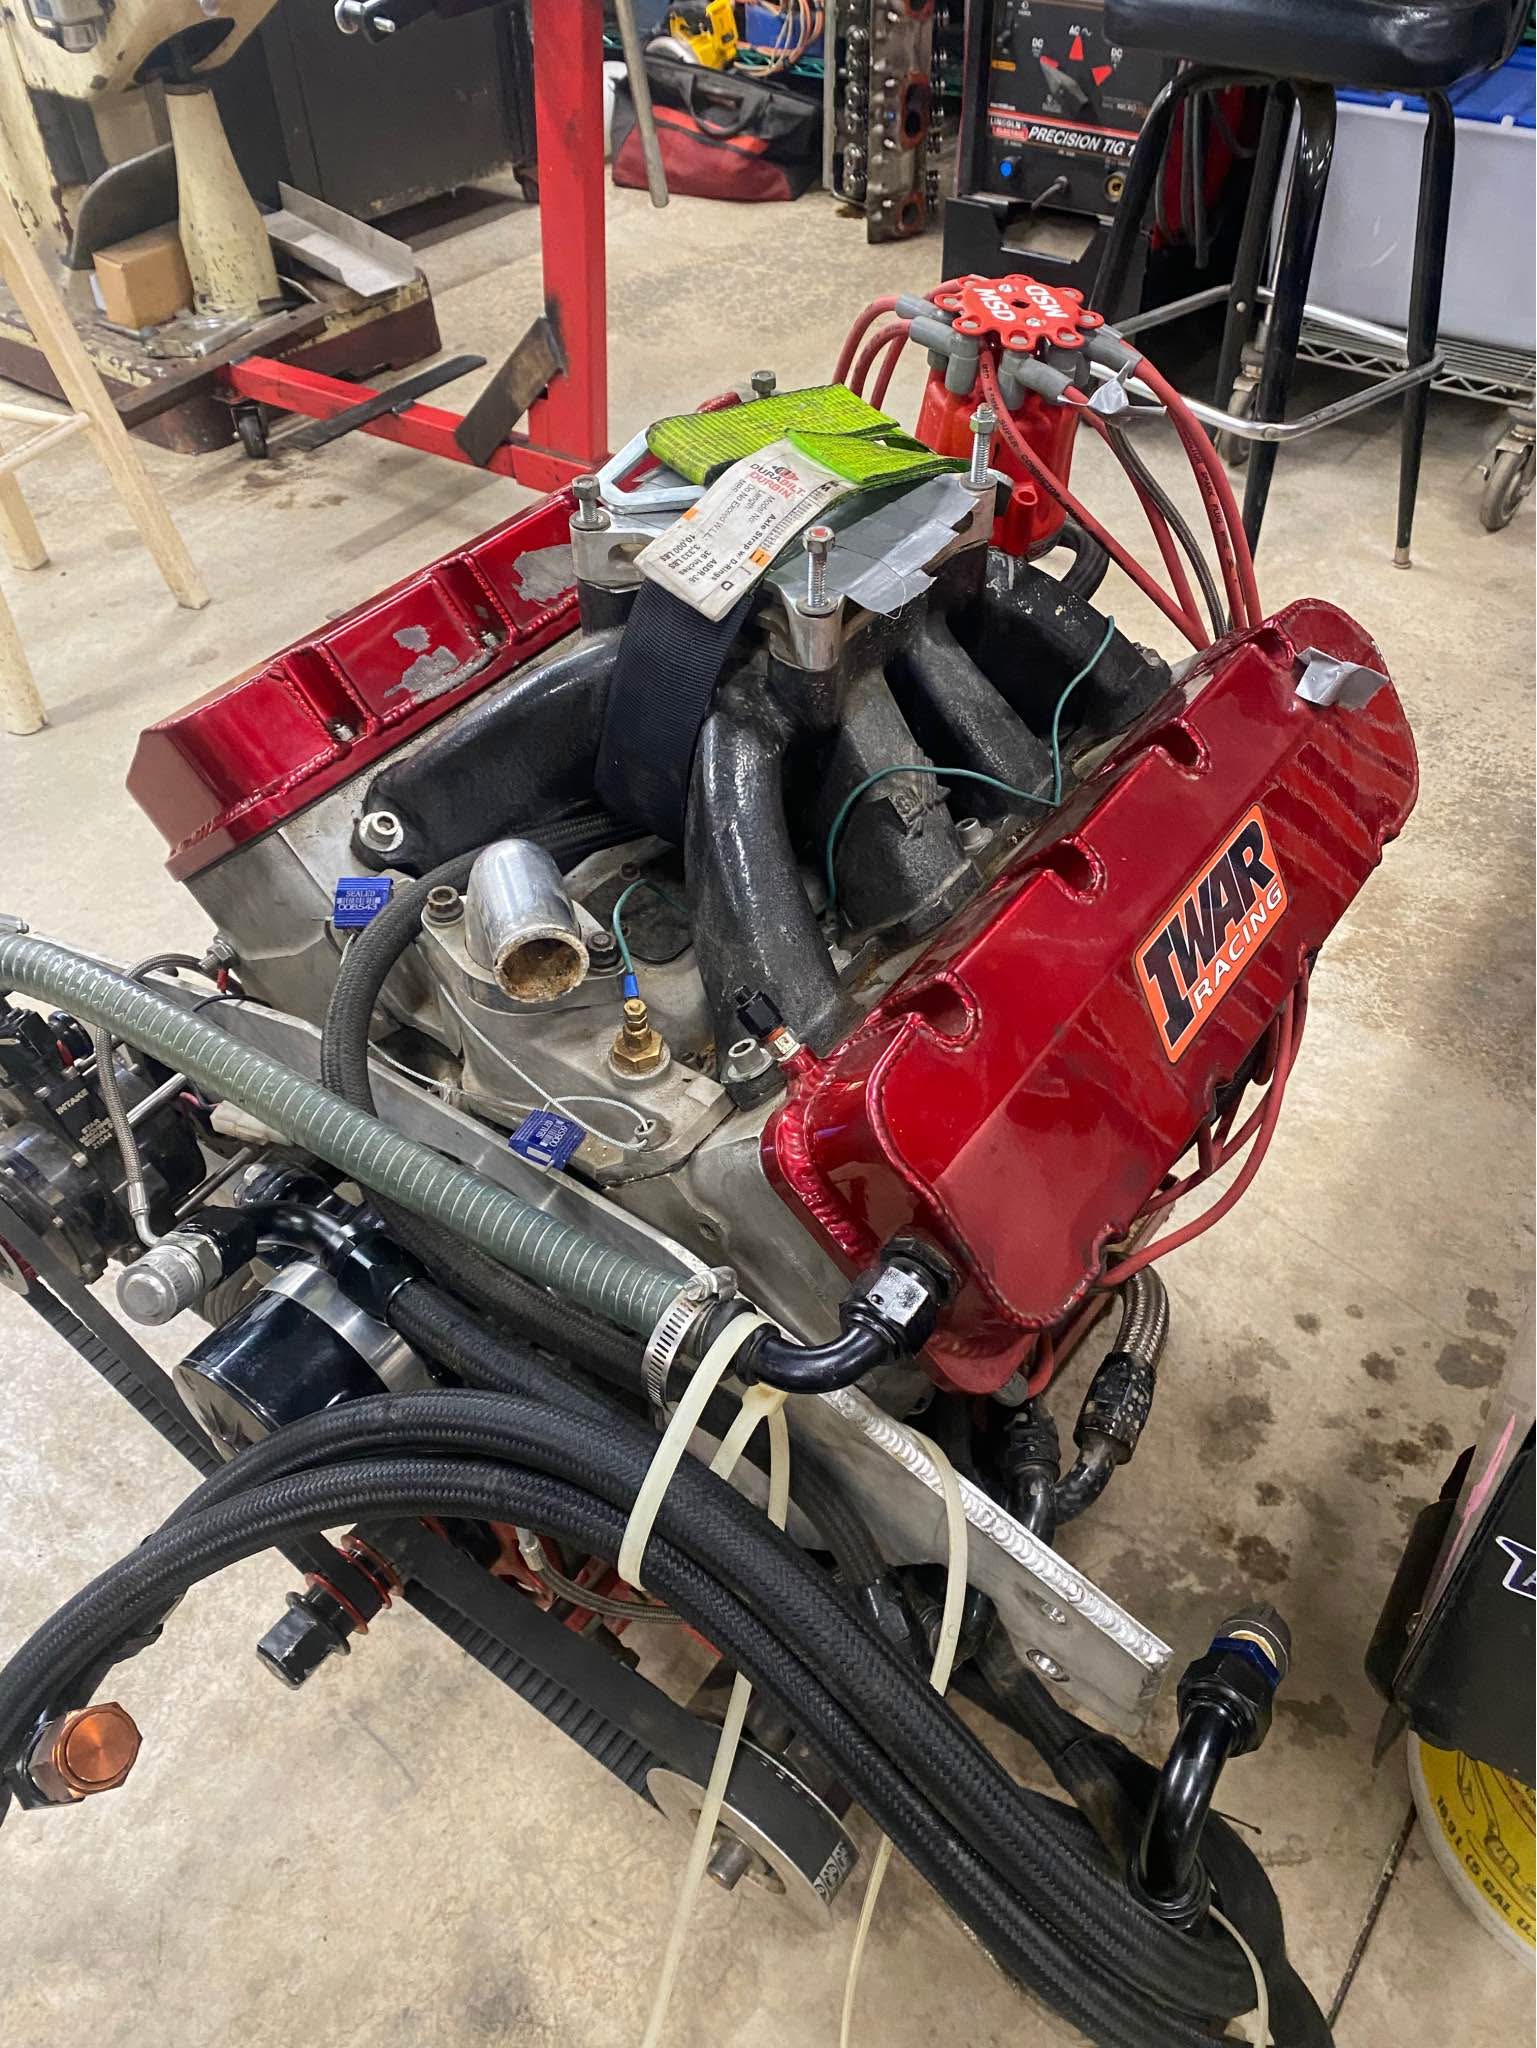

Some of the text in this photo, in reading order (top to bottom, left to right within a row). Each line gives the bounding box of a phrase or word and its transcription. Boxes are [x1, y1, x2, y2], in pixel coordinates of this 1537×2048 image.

[1032, 37, 1044, 48] DC
[1069, 25, 1080, 36] AC
[1111, 47, 1123, 58] DC
[1028, 125, 1101, 151] PRECISION
[1102, 138, 1126, 156] TIG
[973, 287, 1017, 322] MSD
[1024, 285, 1070, 319] MSD
[750, 463, 806, 497] DURABILT
[750, 471, 792, 500] DURBIN
[759, 512, 777, 531] Axle
[741, 528, 763, 551] Strap
[1192, 881, 1283, 1011] RACING
[56, 1088, 89, 1115] INTAKE
[1482, 1878, 1511, 1918] GAL
